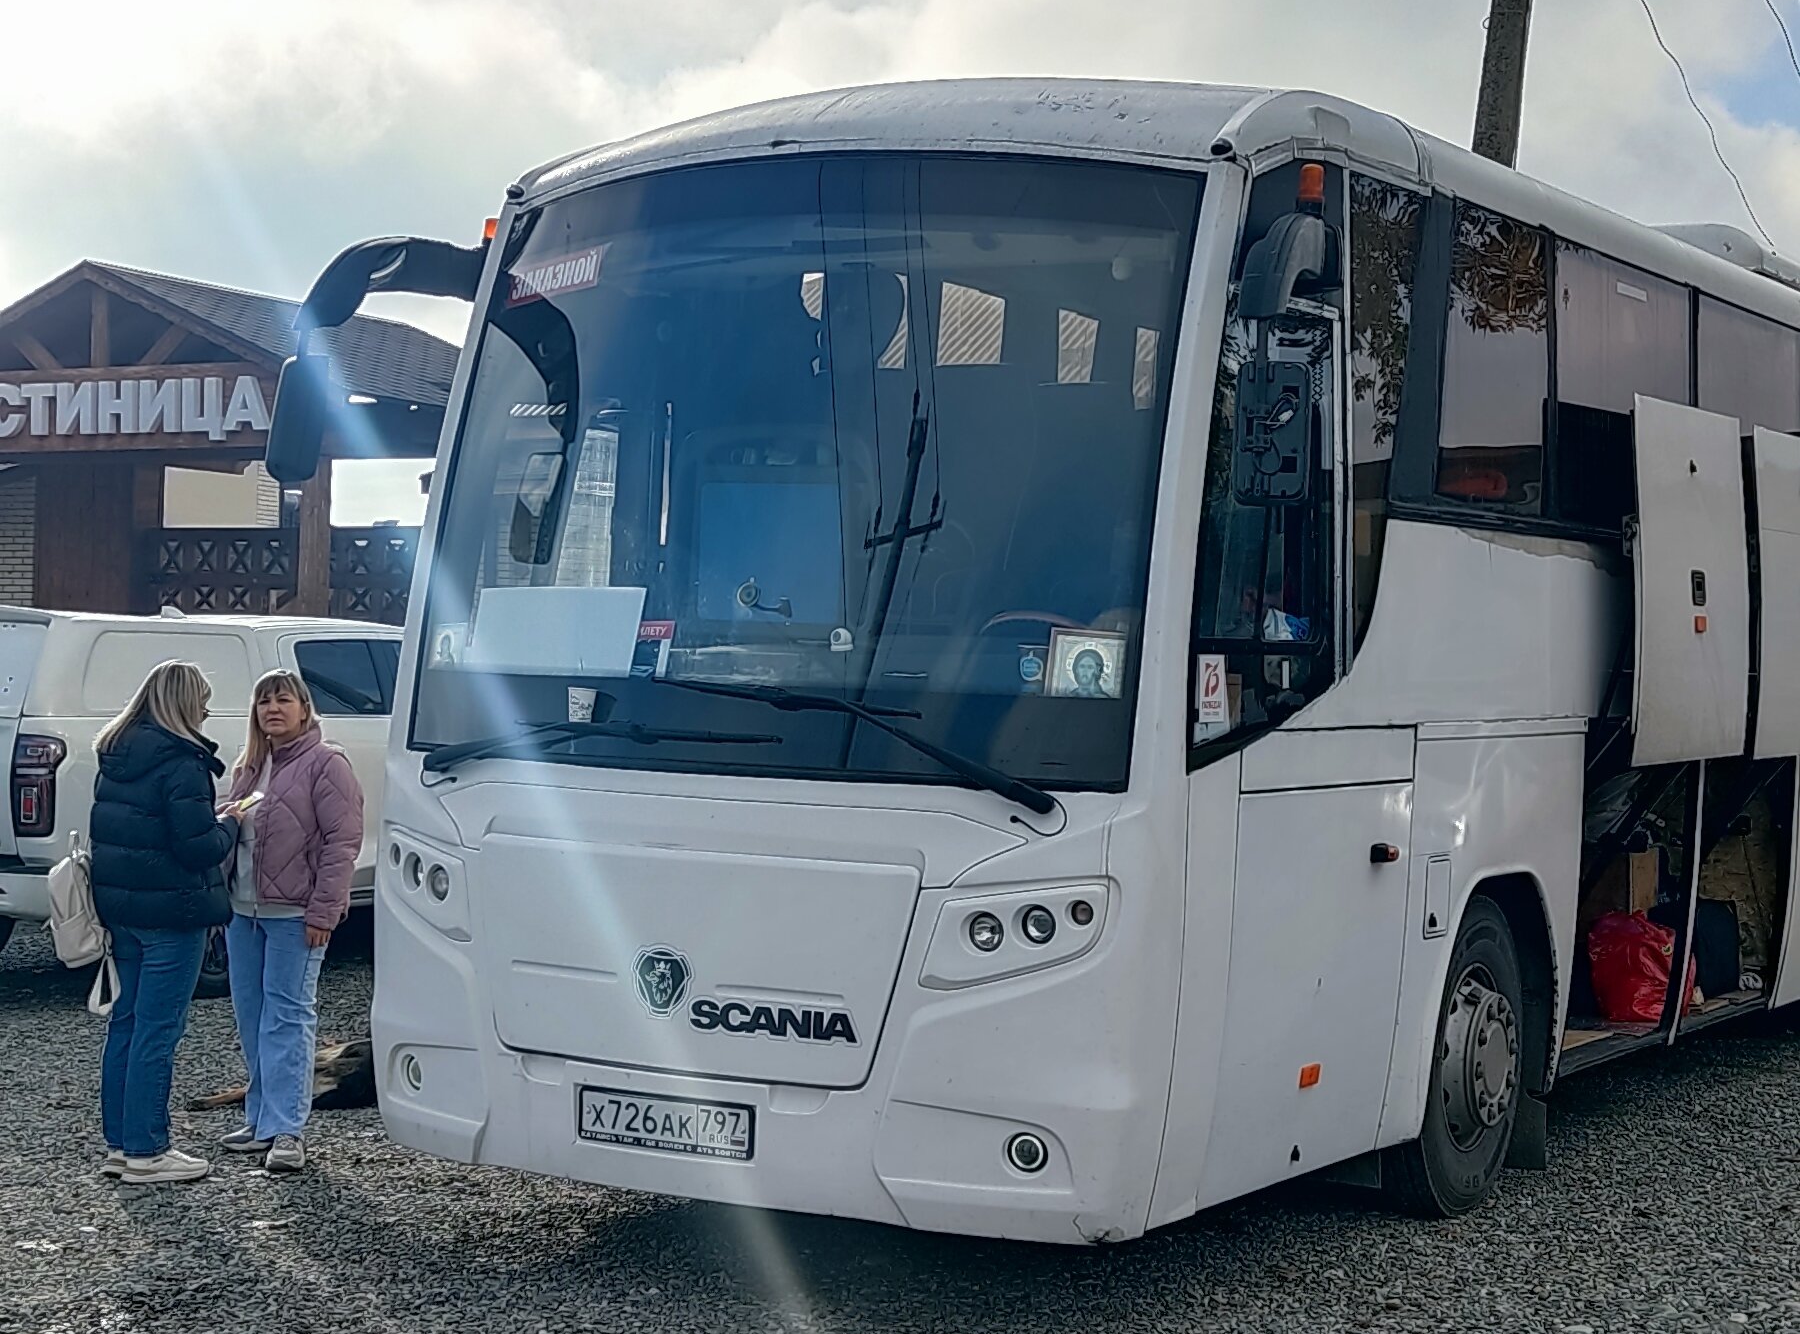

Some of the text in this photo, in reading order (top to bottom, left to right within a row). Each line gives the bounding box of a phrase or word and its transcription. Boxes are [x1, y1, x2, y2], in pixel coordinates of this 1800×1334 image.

[512, 249, 598, 301] ЗАКАЗНОЙ
[689, 1000, 858, 1044] SCANIA
[699, 1109, 741, 1136] 797
[708, 1134, 730, 1145] RUS
